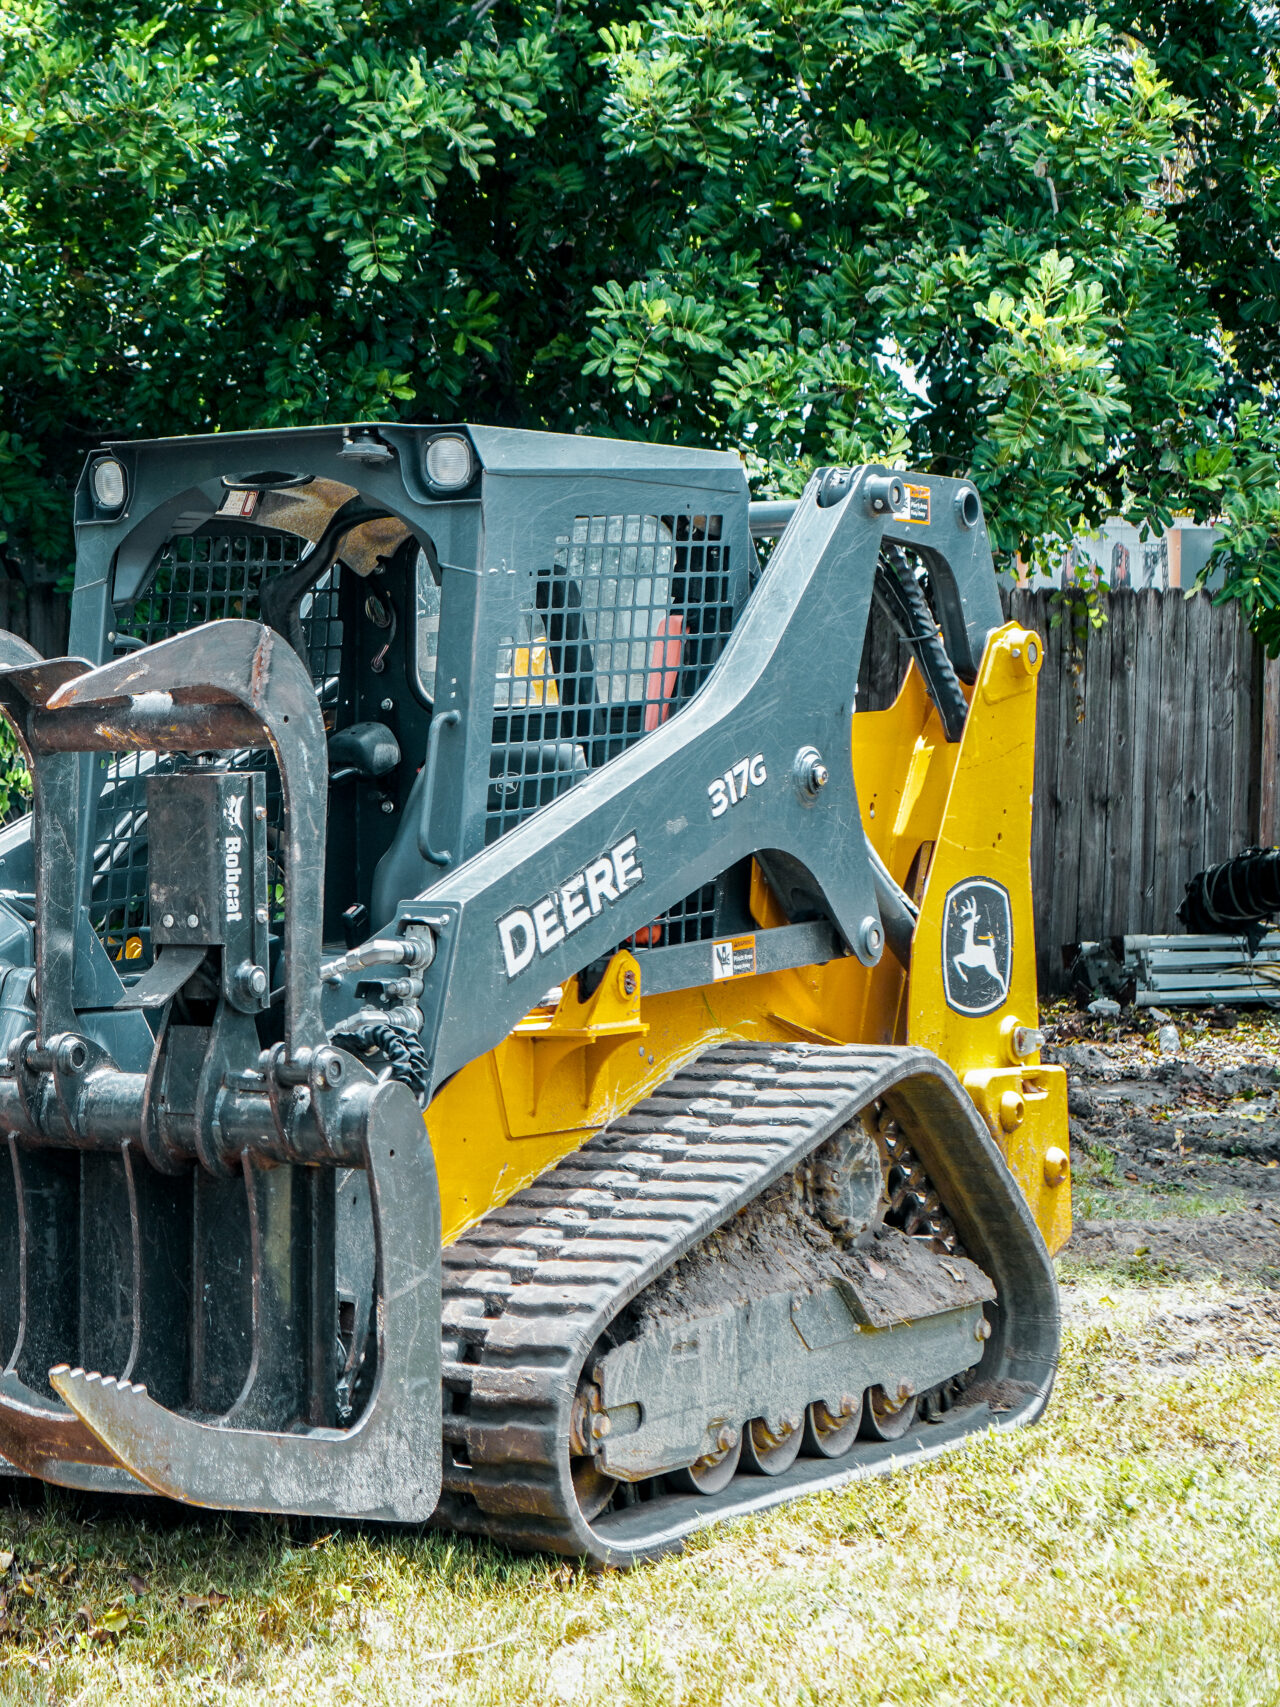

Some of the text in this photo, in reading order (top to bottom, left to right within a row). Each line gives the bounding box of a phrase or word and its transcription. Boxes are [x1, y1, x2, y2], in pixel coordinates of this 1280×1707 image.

[707, 753, 768, 818] 317G
[225, 836, 242, 922] Bobcat
[497, 834, 644, 978] DEERE
